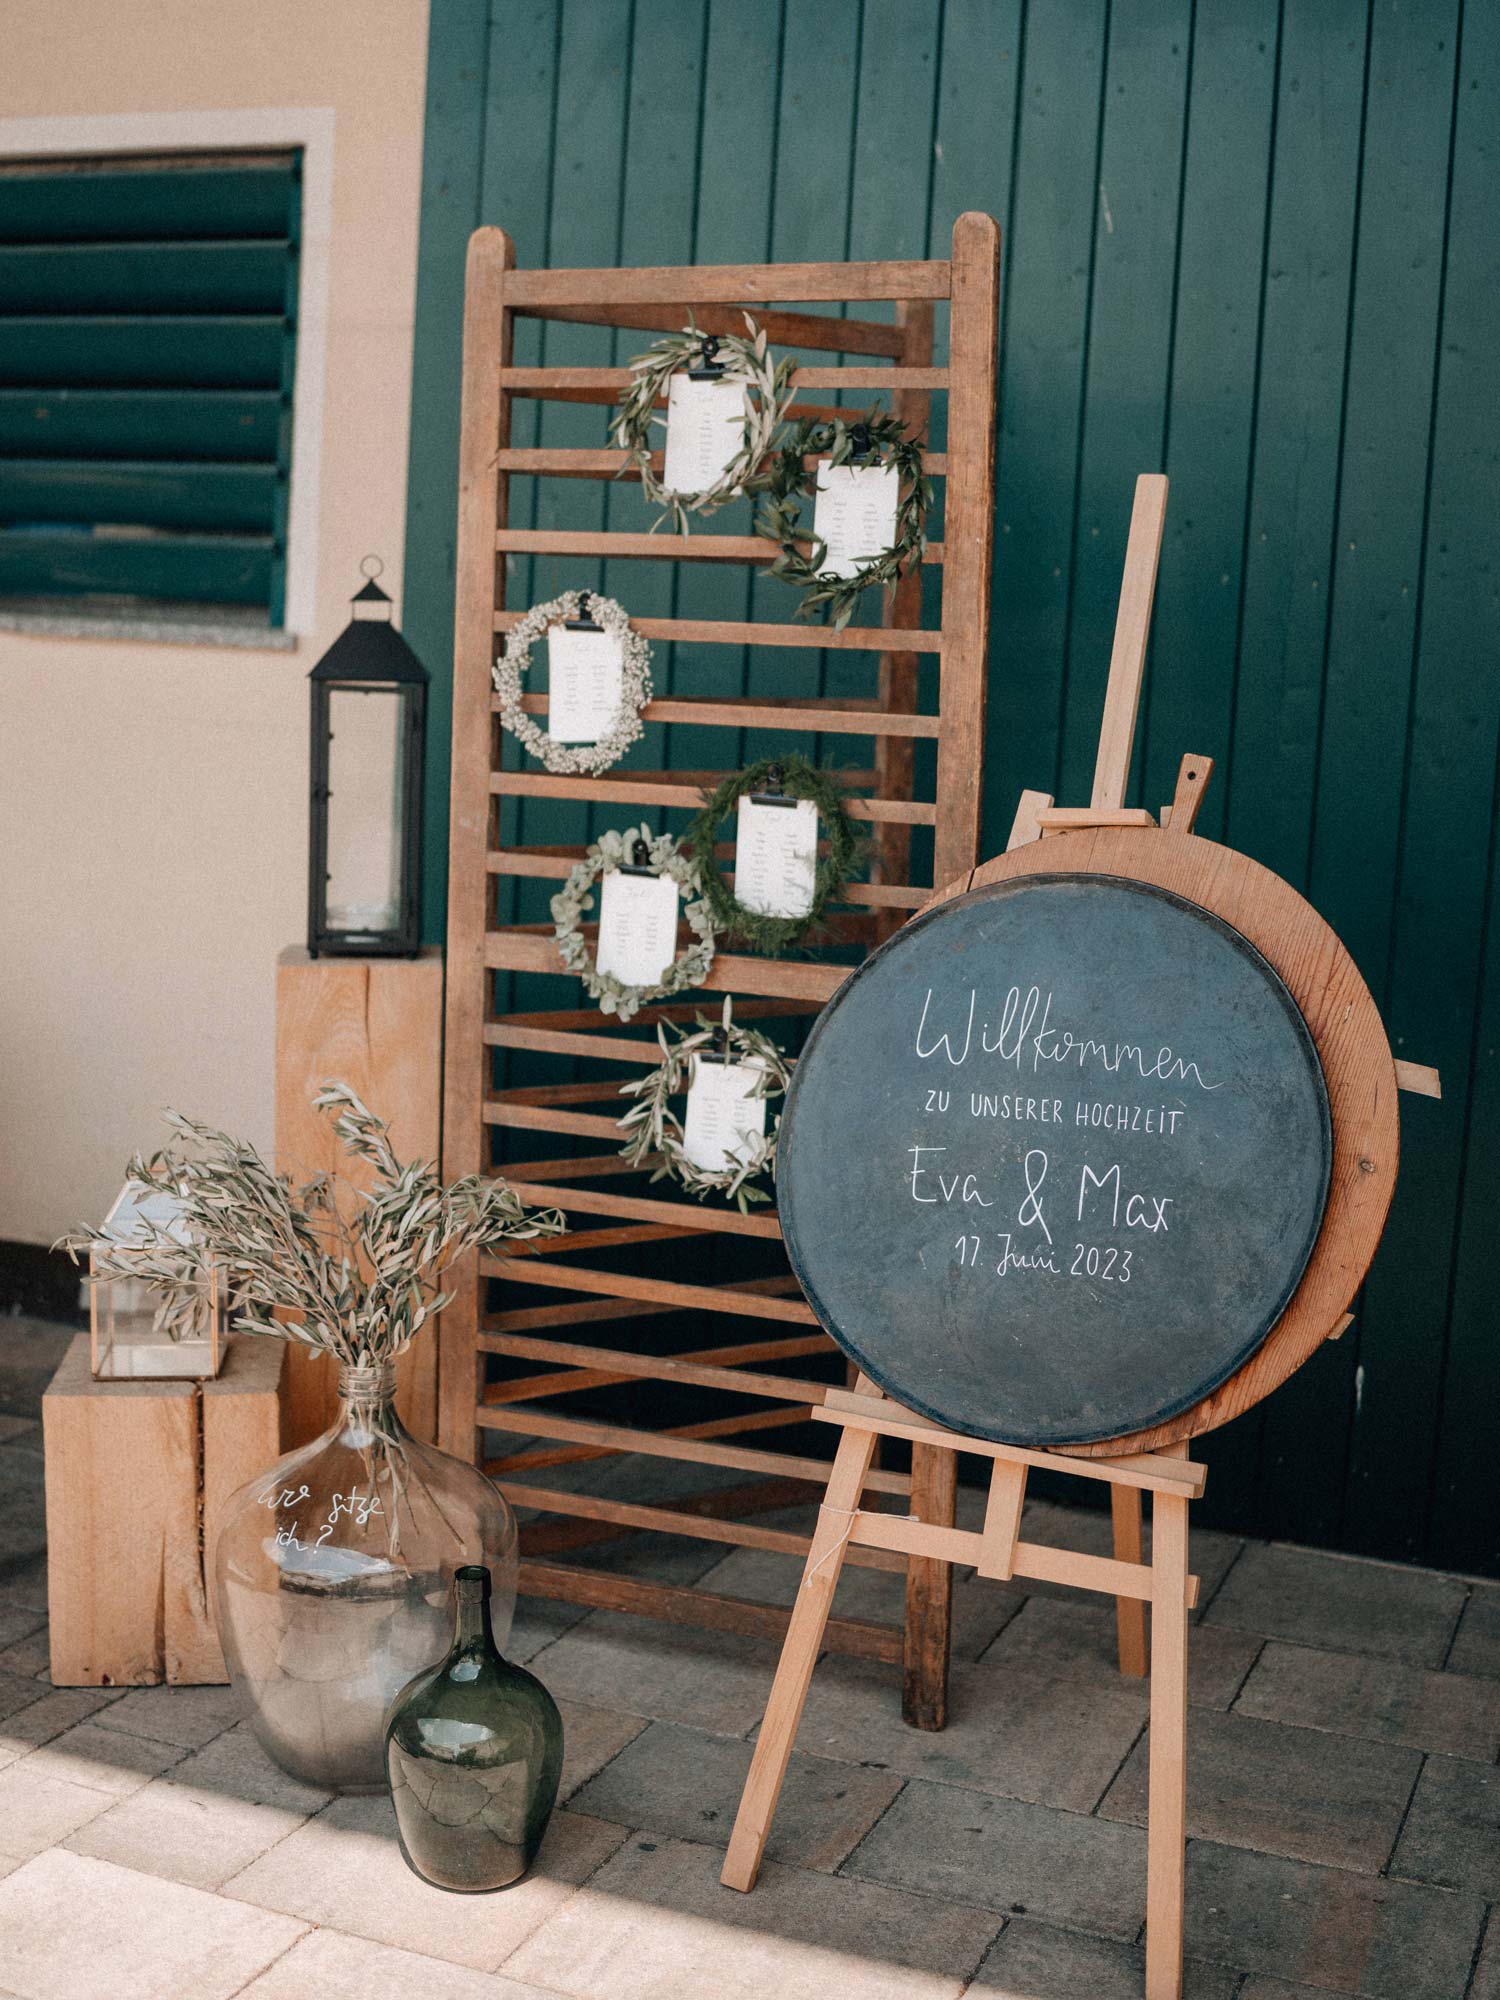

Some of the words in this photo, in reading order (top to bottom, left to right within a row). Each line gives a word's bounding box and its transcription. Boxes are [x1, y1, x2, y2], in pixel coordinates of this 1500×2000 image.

[916, 986, 1225, 1089] Willkommen
[925, 1090, 950, 1112] ZU
[971, 1093, 1063, 1123] UNSERER
[907, 1146, 994, 1206] Eva
[1018, 1149, 1052, 1244] &
[1077, 1164, 1174, 1232] Max
[997, 1233, 1061, 1276] Juni
[1070, 1243, 1133, 1282] 2023
